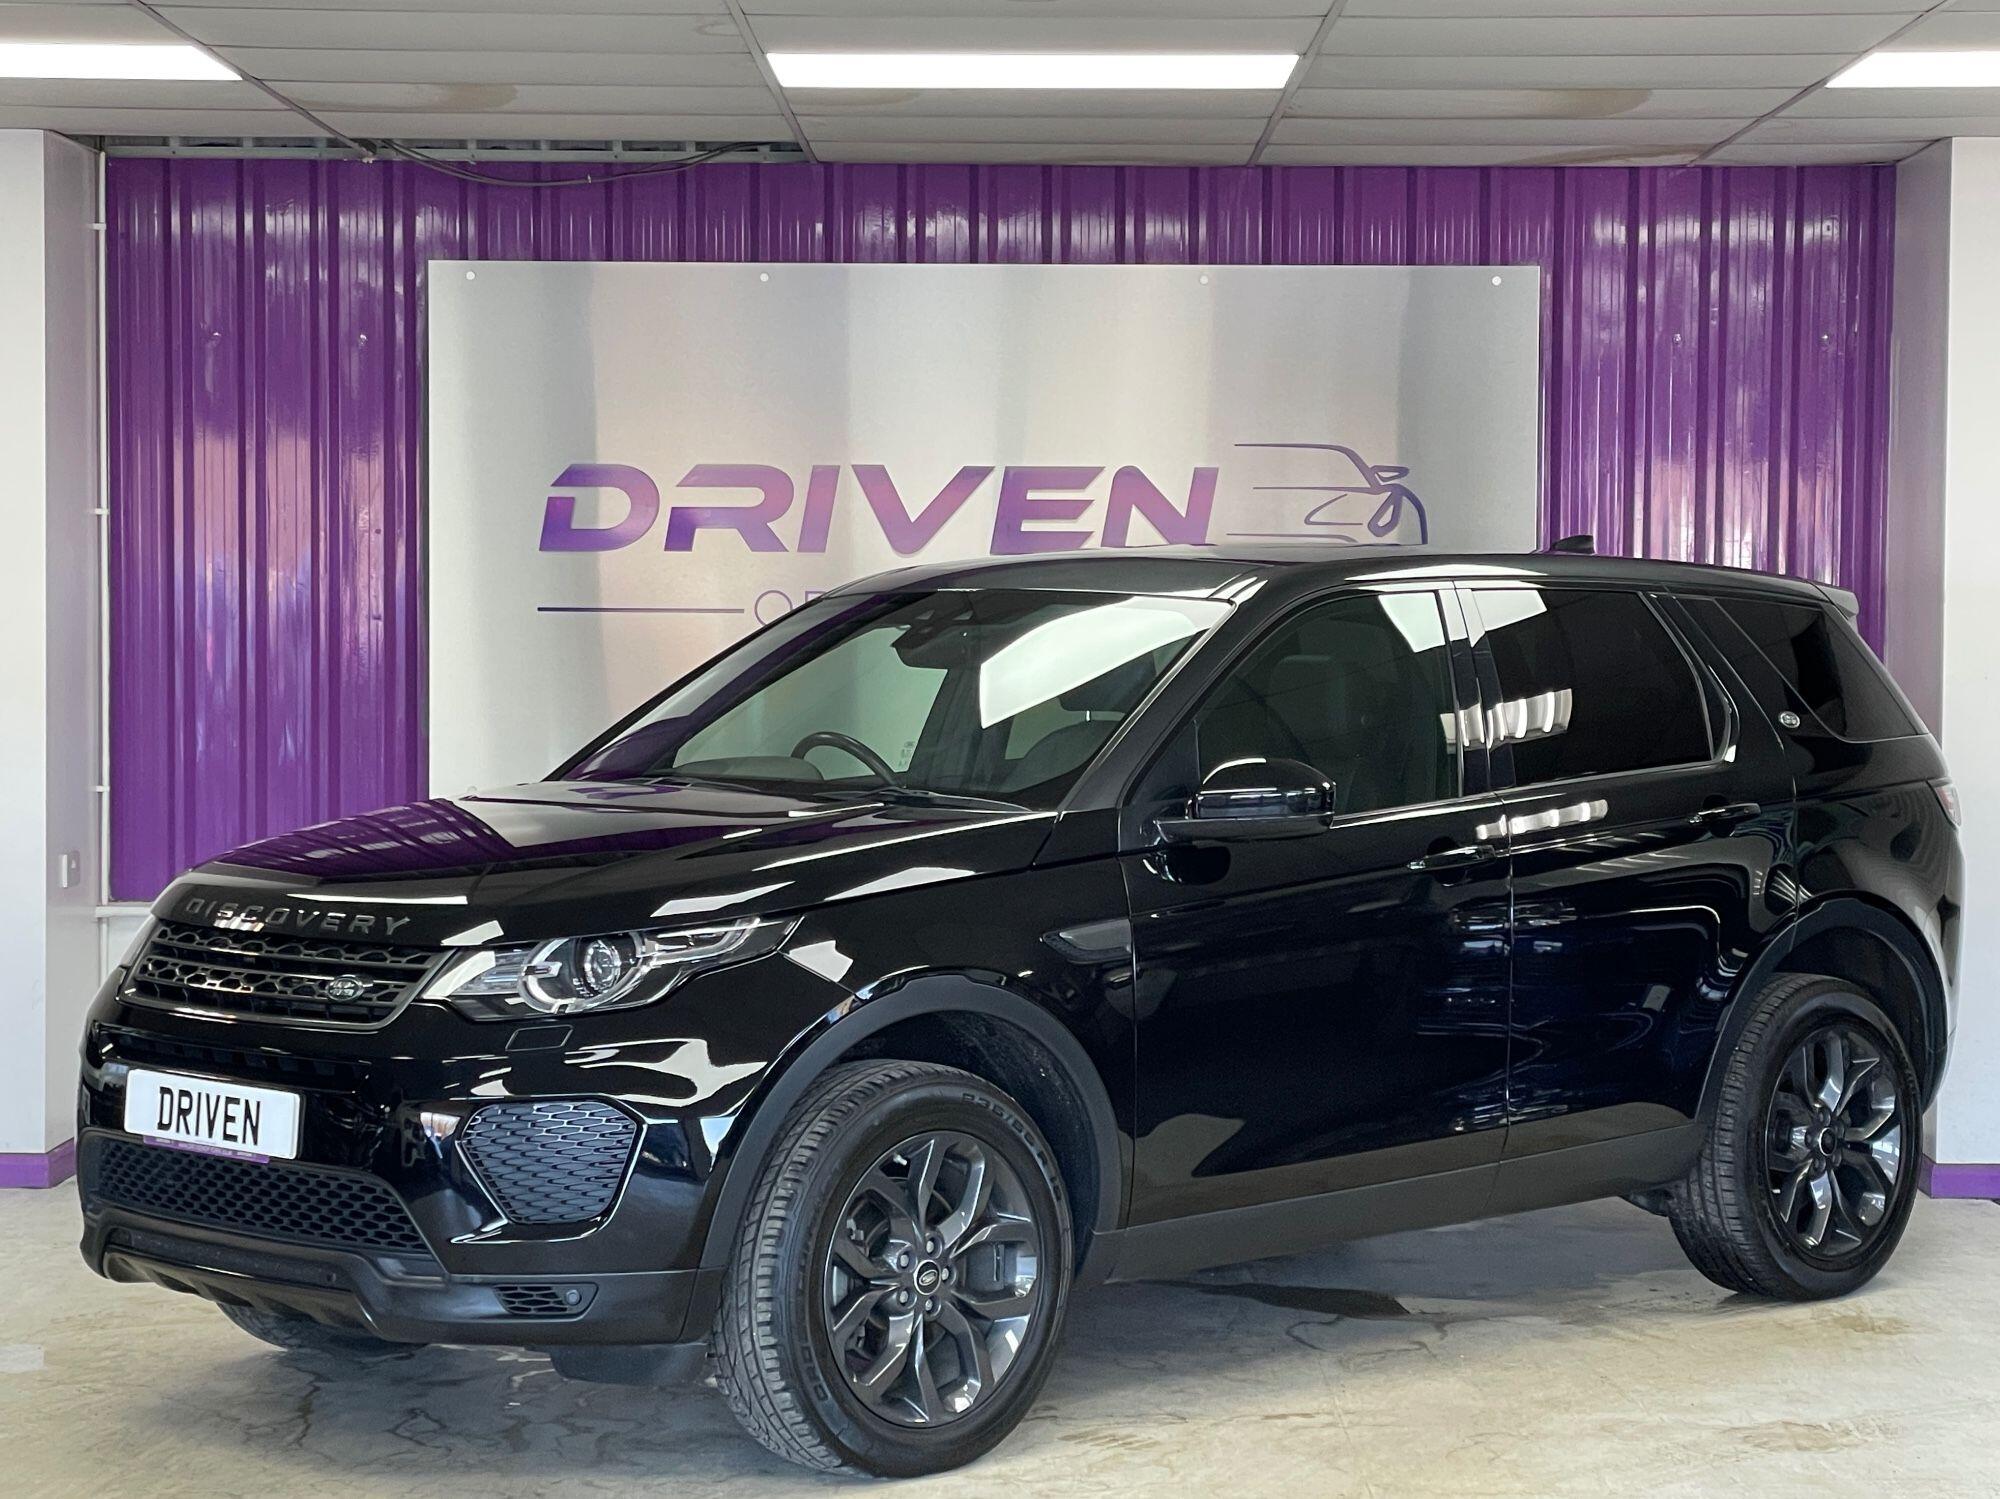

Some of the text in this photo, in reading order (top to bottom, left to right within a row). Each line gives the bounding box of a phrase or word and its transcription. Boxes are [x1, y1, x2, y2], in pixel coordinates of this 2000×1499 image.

[538, 463, 1219, 556] DRIVEN
[185, 897, 411, 936] DISCOVERY
[157, 1086, 261, 1146] DRIVEN
